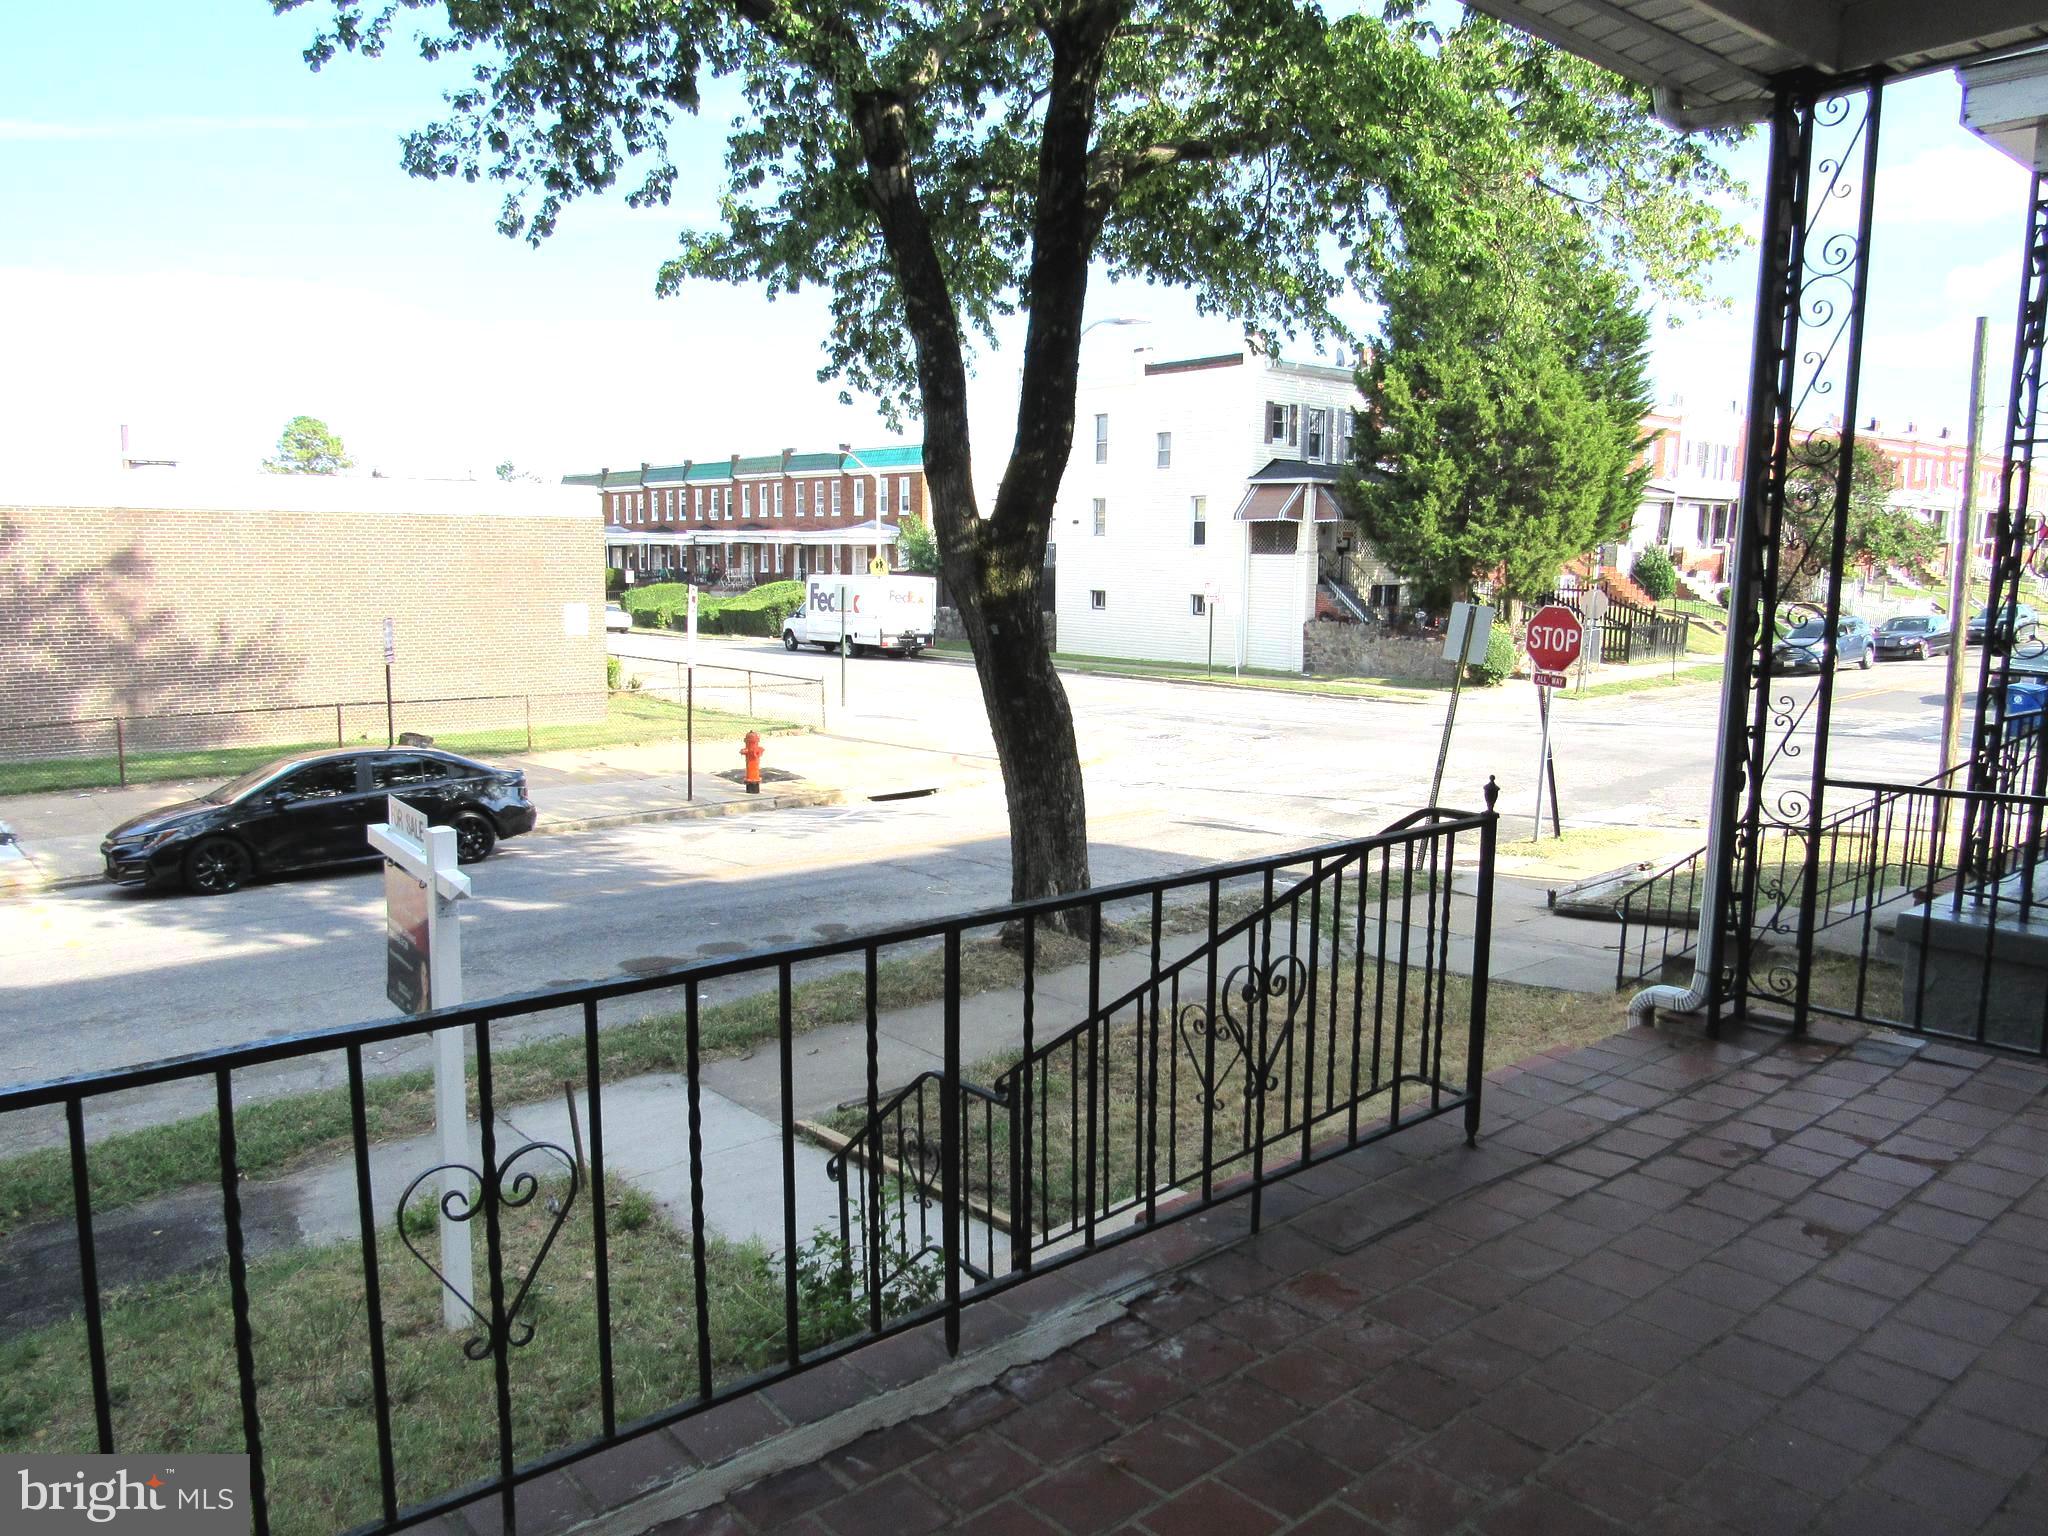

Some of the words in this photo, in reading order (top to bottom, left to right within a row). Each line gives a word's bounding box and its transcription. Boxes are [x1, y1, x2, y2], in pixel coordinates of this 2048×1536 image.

[1530, 626, 1578, 652] STOP
[1535, 675, 1548, 684] ALL
[1551, 677, 1563, 686] WAY
[391, 804, 404, 831] FOR
[406, 813, 425, 842] SALE
